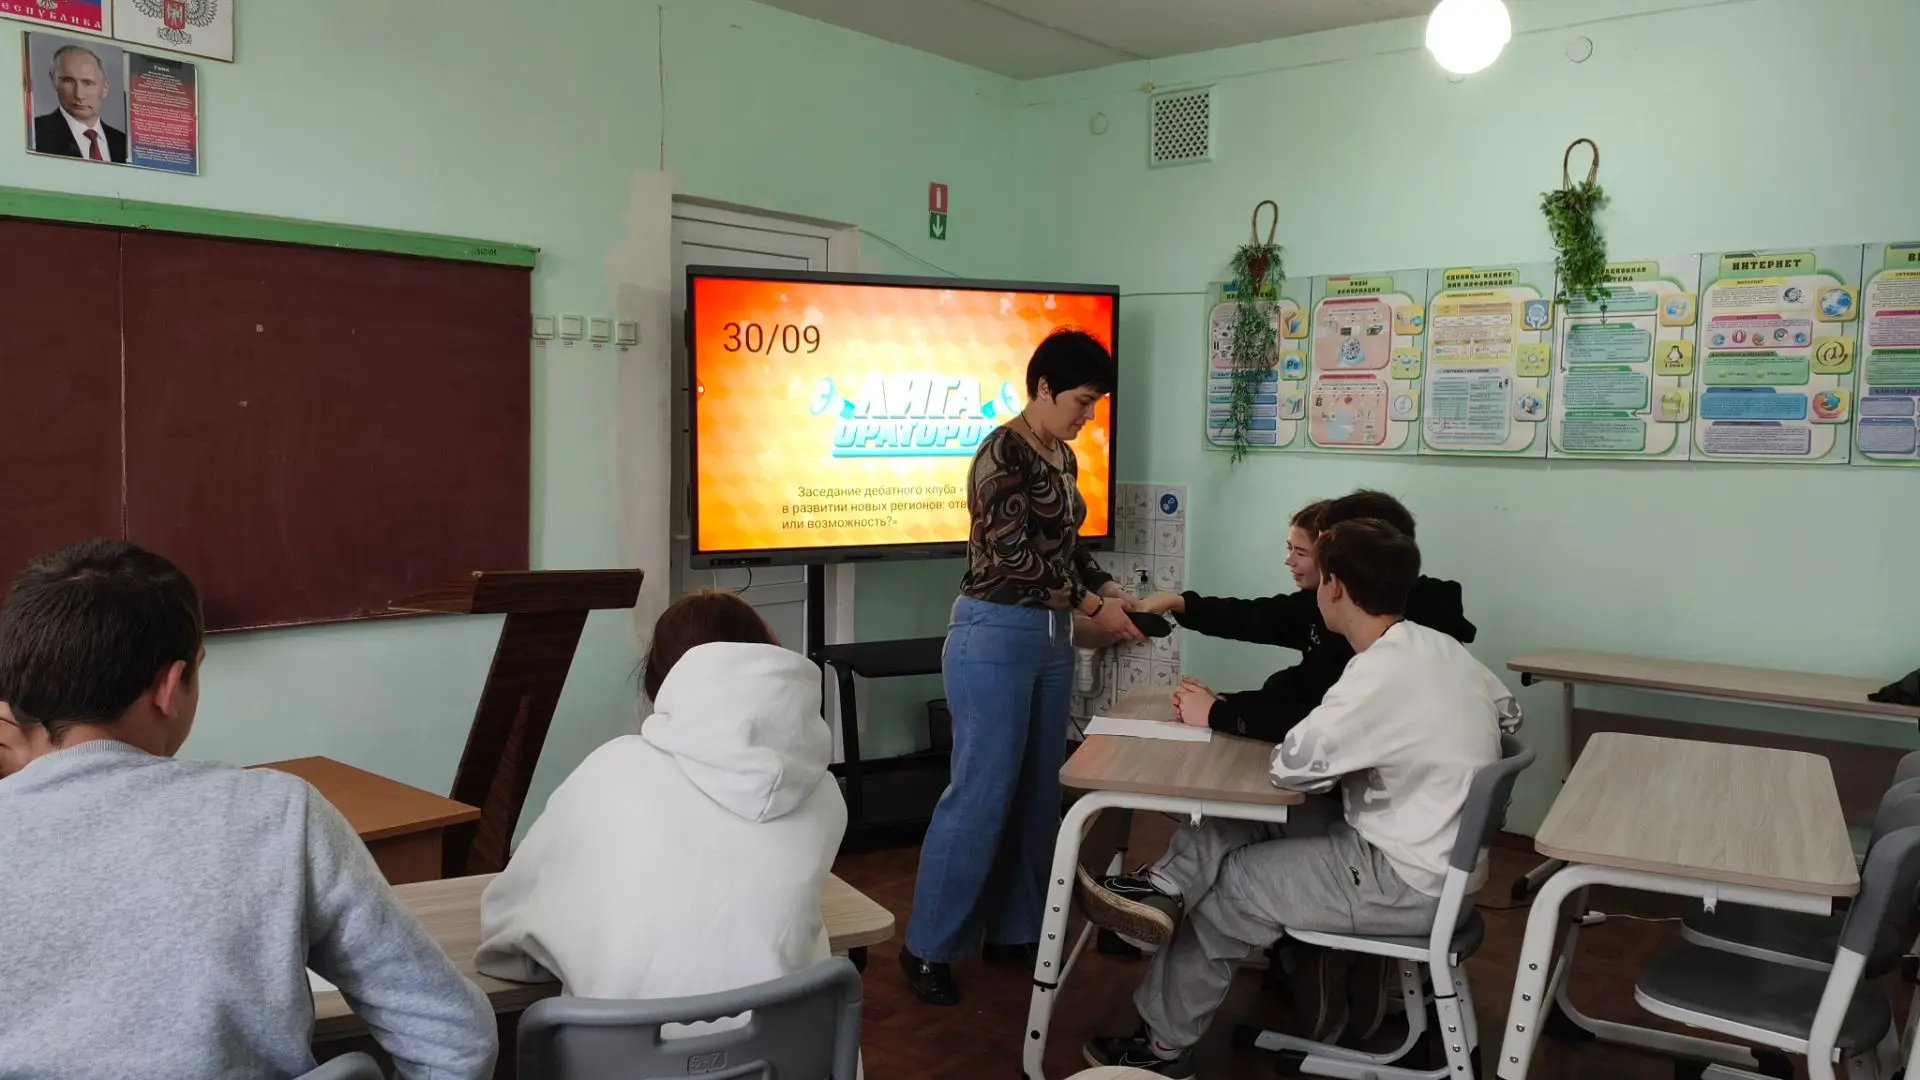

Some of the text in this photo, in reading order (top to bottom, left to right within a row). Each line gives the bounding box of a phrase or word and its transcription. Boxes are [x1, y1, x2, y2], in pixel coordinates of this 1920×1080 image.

[1, 3, 101, 28] ЕСПУБЛИКА
[1732, 259, 1802, 270] ИНТЕРНЕТ
[723, 322, 820, 355] 30/09
[853, 377, 985, 419] ЛИГА
[798, 486, 862, 498] Заседание
[864, 485, 922, 497] дебатного
[925, 484, 956, 496] клуба
[792, 504, 848, 515] развитии
[850, 503, 887, 512] новых
[890, 501, 945, 512] регионов:
[782, 516, 898, 529] или возможность?»
